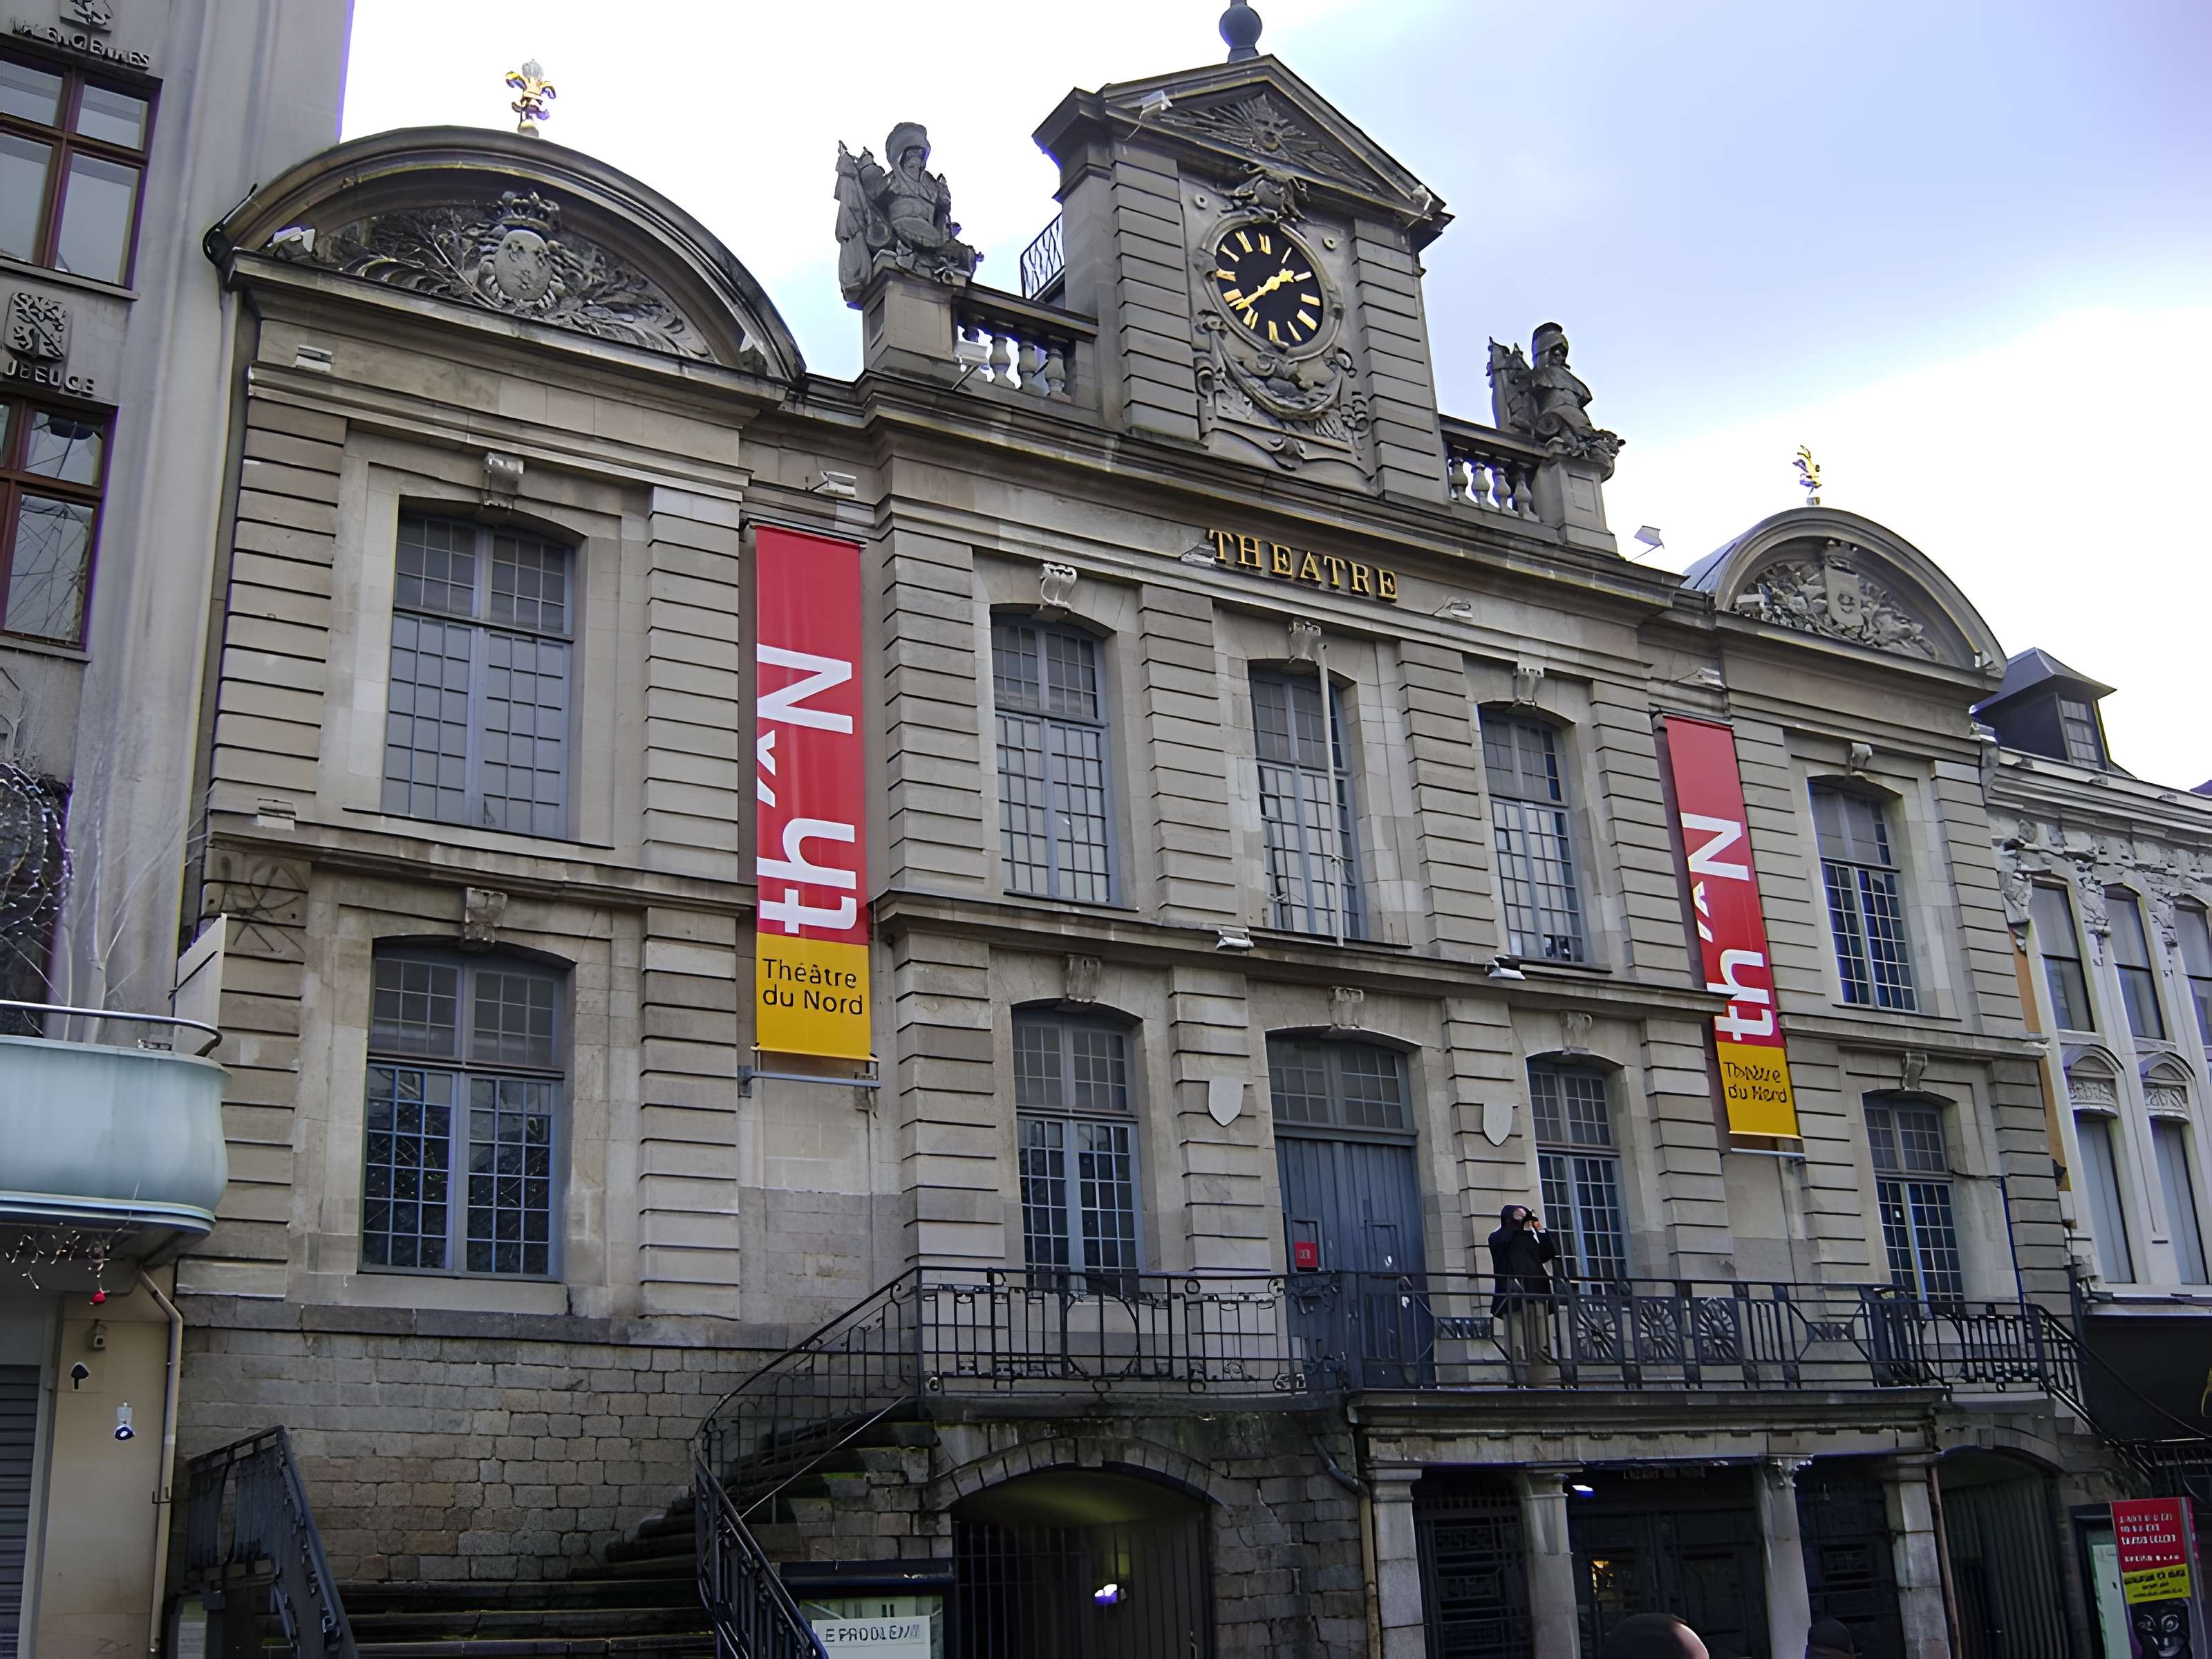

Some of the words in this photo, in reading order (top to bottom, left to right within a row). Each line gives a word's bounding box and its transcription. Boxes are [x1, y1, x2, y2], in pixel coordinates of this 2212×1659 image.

[1208, 529, 1398, 603] THEATRE
[762, 958, 857, 988] Théâtre
[762, 984, 794, 1007] du
[803, 989, 863, 1015] Nord
